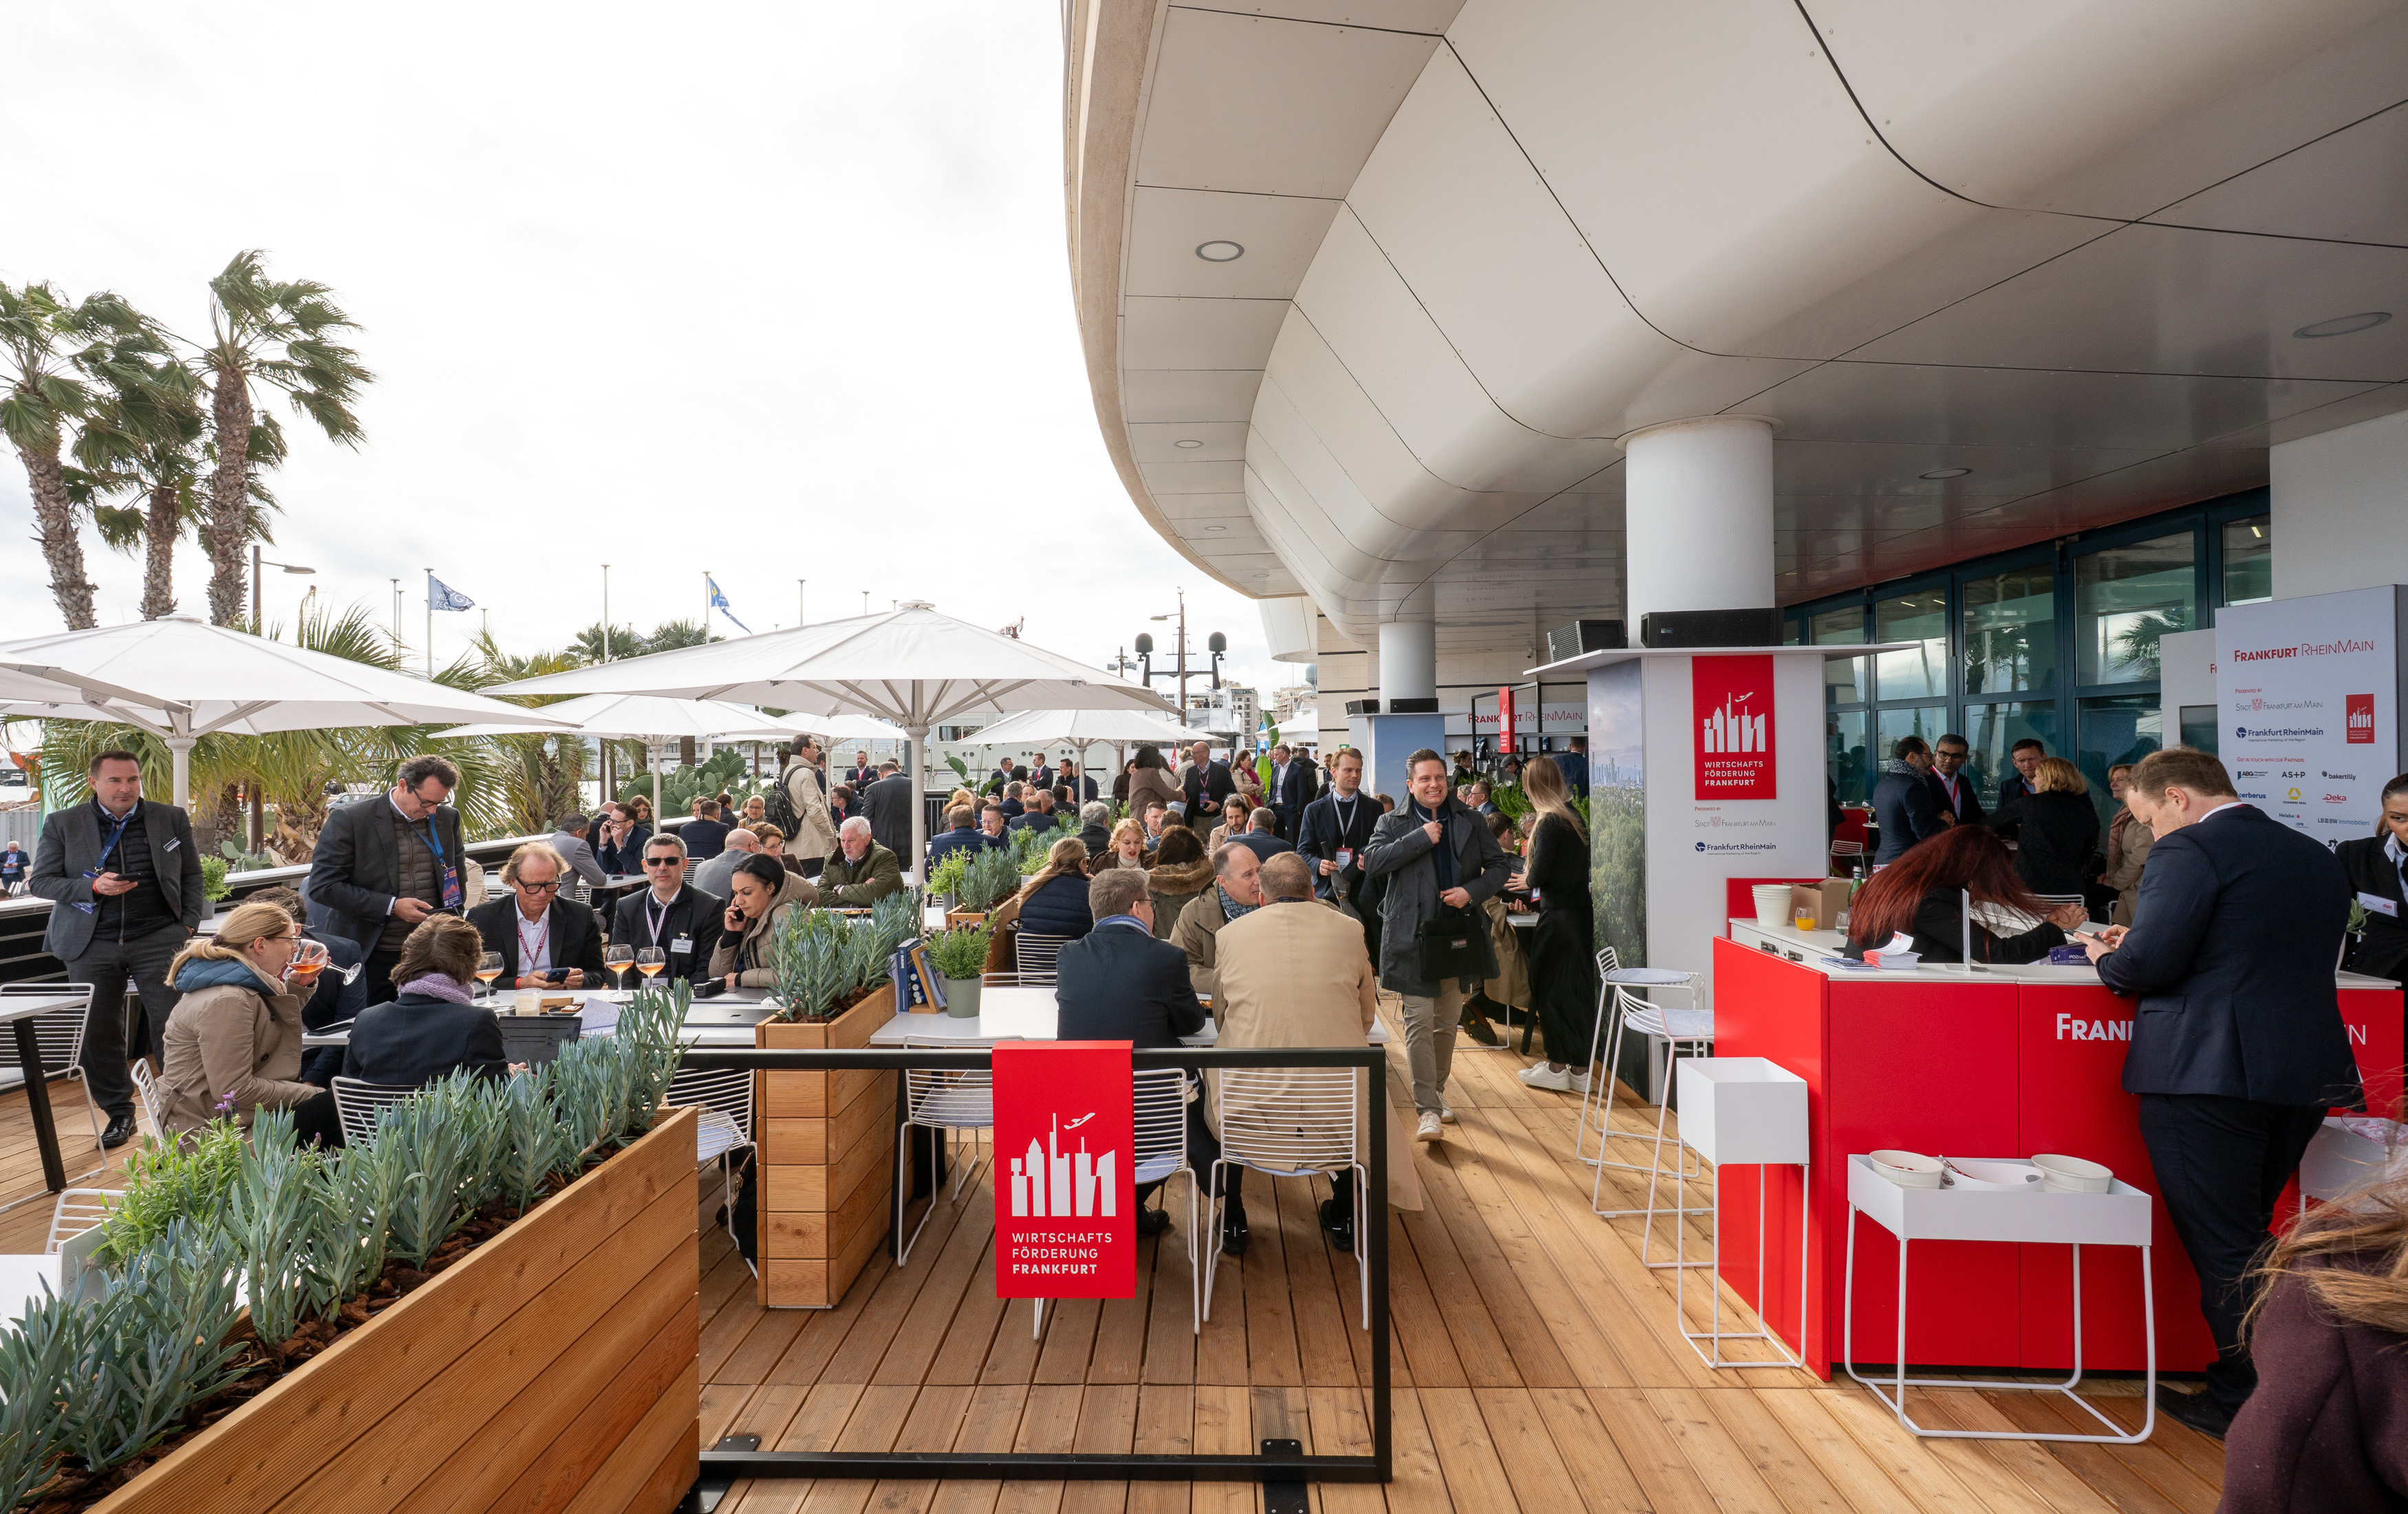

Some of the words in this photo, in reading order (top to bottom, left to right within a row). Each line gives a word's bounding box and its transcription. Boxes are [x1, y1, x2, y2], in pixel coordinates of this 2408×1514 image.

[2234, 647, 2298, 662] FRANKFURT
[2301, 639, 2374, 657] RHEINMAIN
[2235, 703, 2251, 712] STADT
[2263, 702, 2293, 710] FRANKFURT
[2303, 700, 2323, 709] MAIN
[1468, 714, 1523, 723] FRANKRT
[1721, 819, 1749, 827] FRANKFURT
[1011, 1233, 1112, 1243] WIRTSCHAFTS
[1012, 1246, 1098, 1259] FÖRDERUNG
[1013, 1264, 1097, 1275] FRANKFURT
